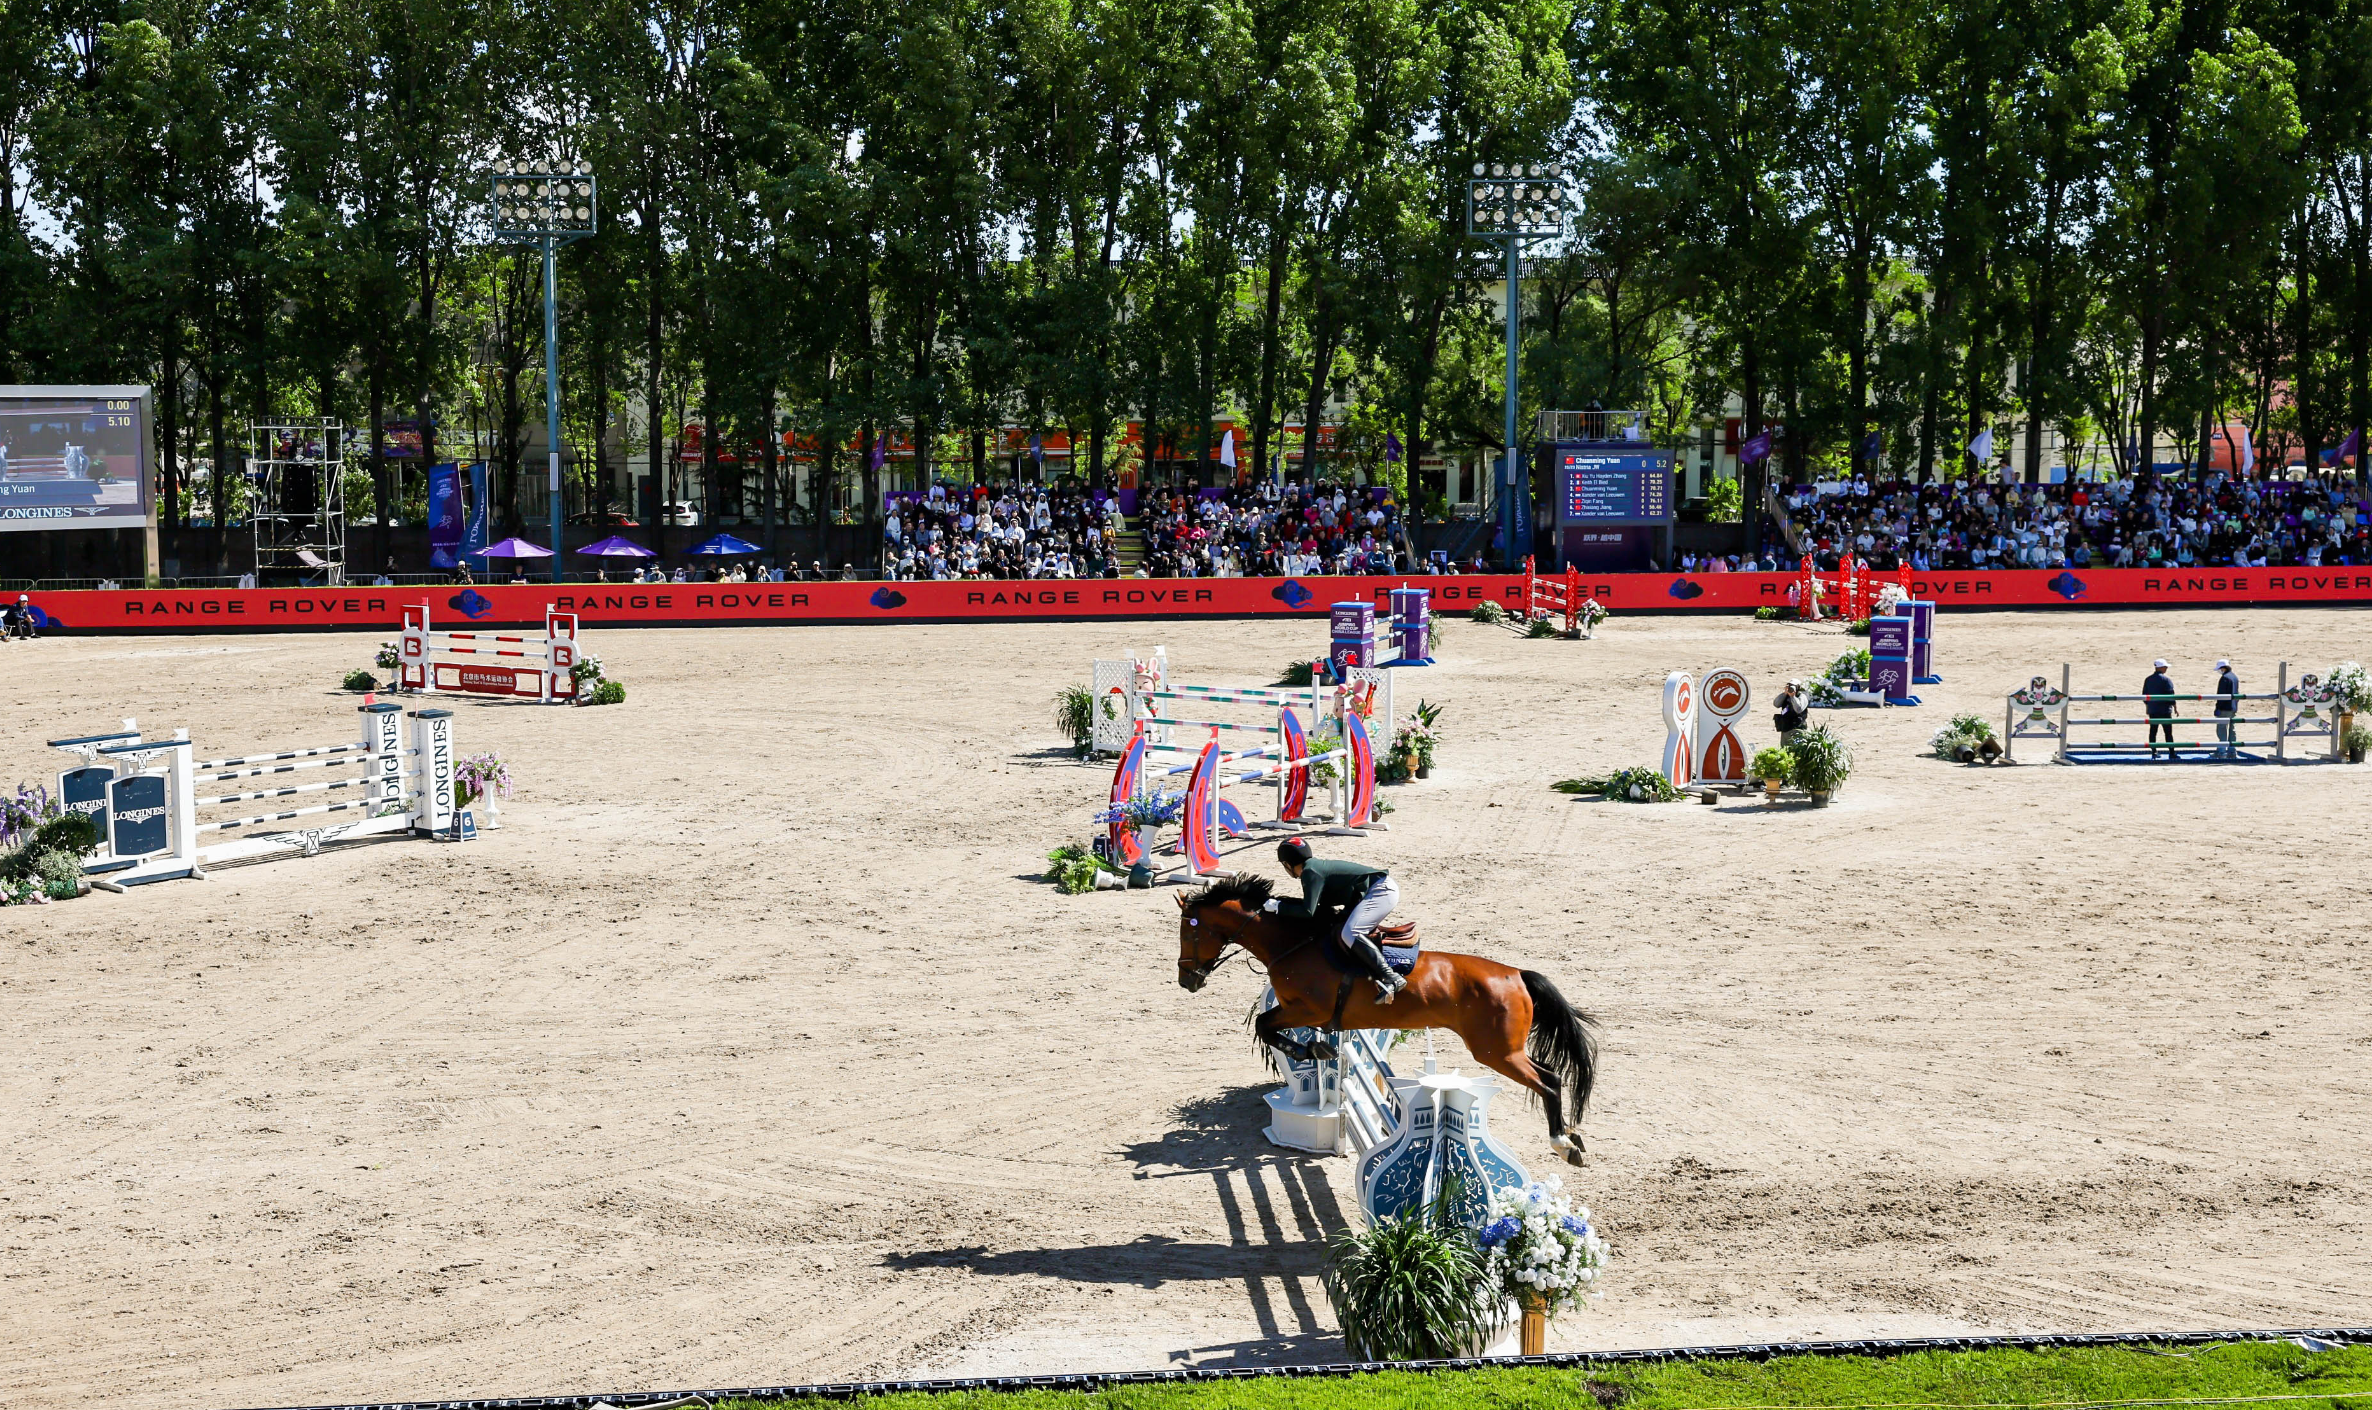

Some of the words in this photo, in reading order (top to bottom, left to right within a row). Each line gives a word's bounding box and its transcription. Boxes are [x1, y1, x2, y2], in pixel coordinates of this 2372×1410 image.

[107, 400, 130, 410] 0.00
[108, 416, 130, 426] 5.10
[12, 484, 35, 493] Yuan
[0, 506, 72, 518] LONGINES
[2144, 578, 2248, 590] RANGE
[2270, 577, 2371, 589] ROVER
[968, 592, 1079, 604] RANGE
[1103, 590, 1212, 603] ROVER
[1374, 587, 1482, 600] RNGE
[126, 601, 244, 614] RANGE
[270, 599, 386, 612] ROVER
[558, 596, 672, 609] RANGE
[697, 594, 808, 608] ROVER
[433, 720, 450, 818] LONGINES
[114, 806, 165, 820] LONGINES
[454, 818, 458, 826] 6
[464, 817, 471, 826] 6
[1096, 845, 1102, 854] 3
